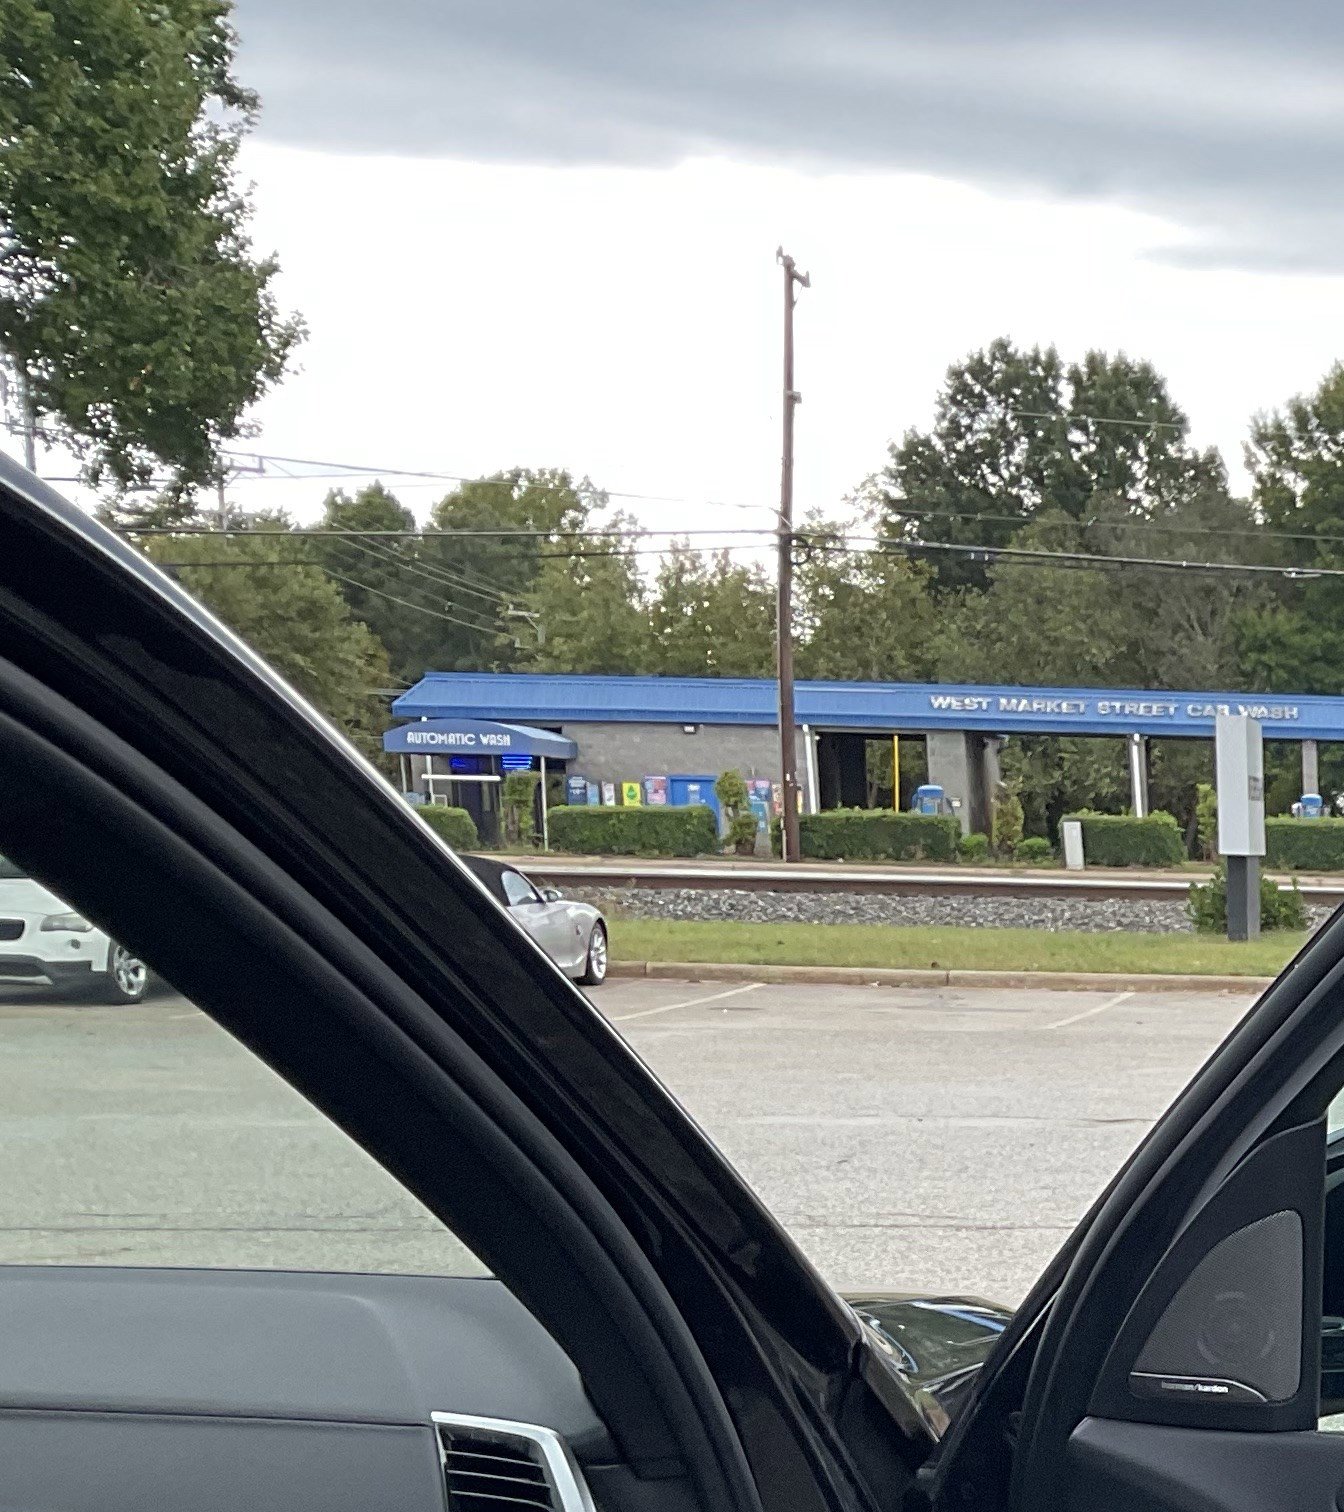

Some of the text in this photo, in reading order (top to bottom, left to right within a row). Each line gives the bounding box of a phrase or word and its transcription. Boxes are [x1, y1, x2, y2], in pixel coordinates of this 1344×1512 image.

[930, 695, 1299, 720] WEST MARKET STREET CAR WASH
[406, 731, 511, 746] AUTOMATIC WASH
